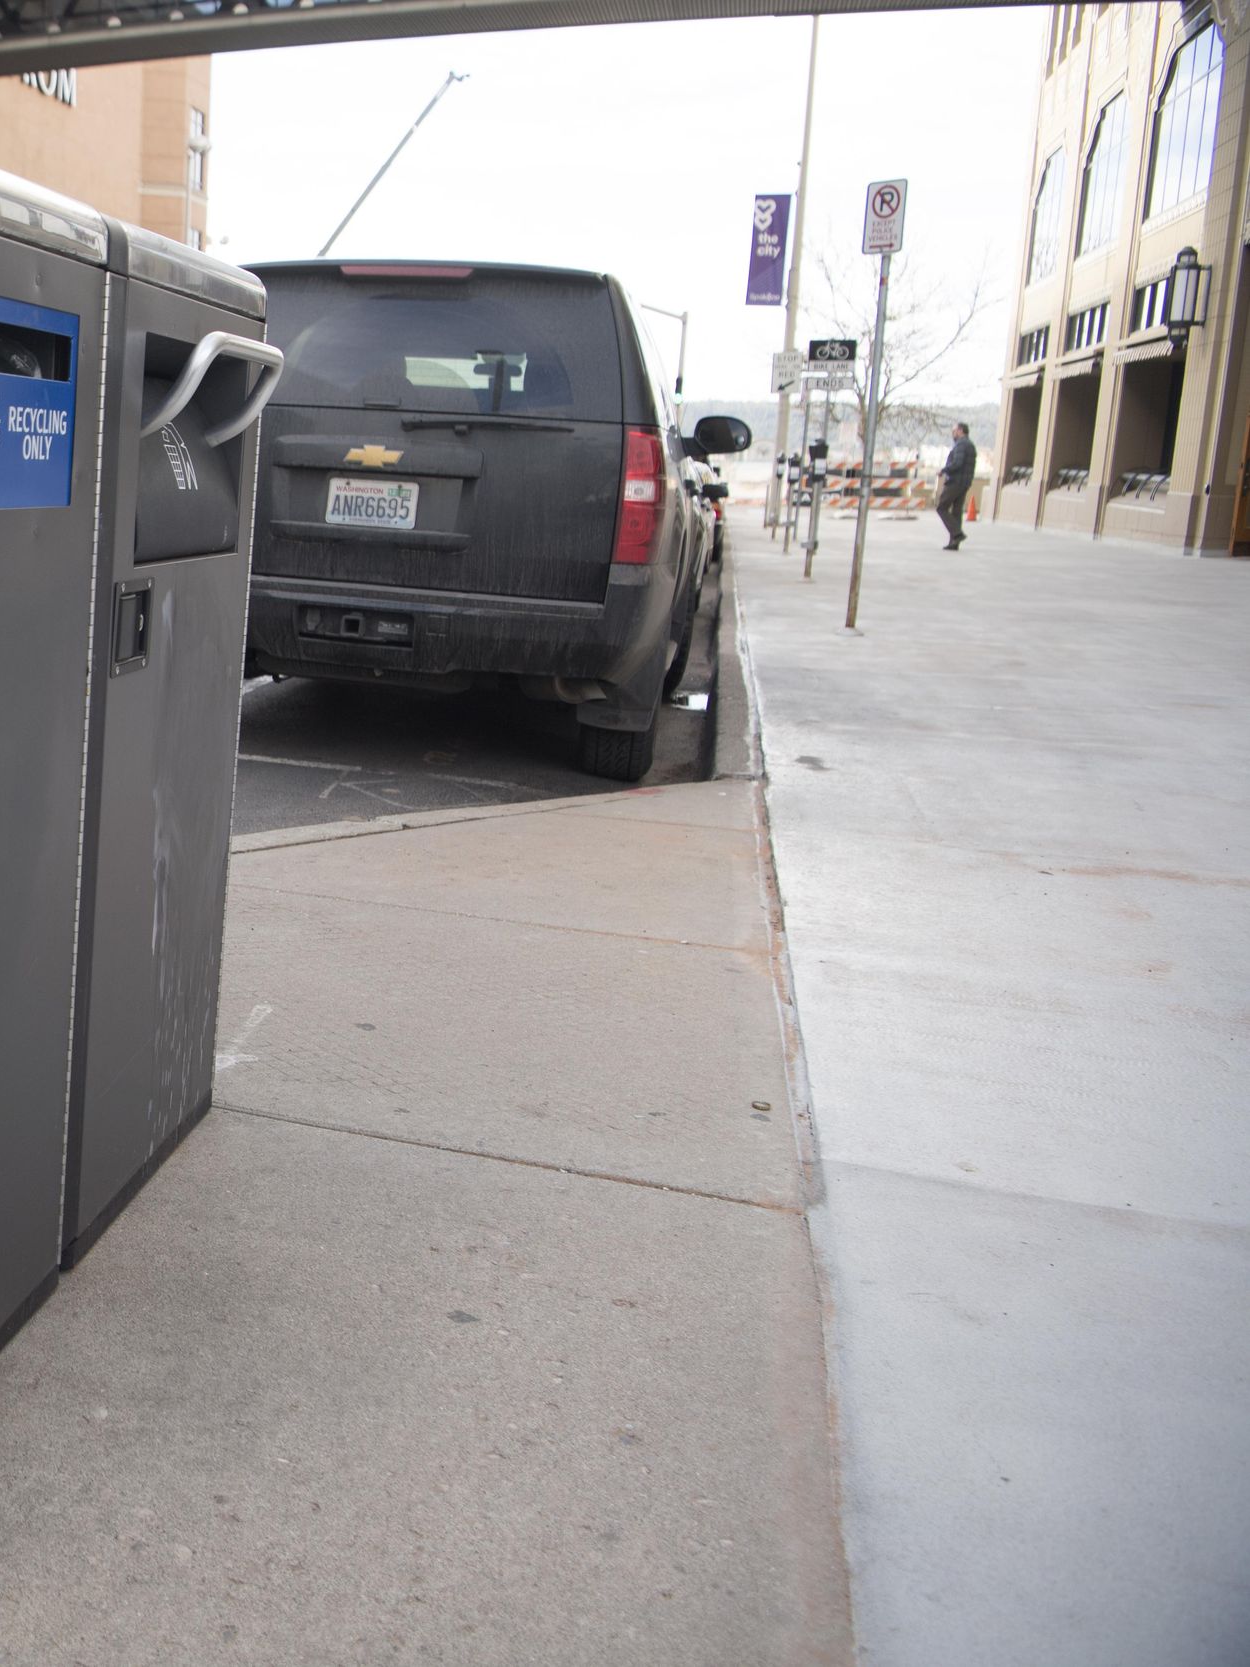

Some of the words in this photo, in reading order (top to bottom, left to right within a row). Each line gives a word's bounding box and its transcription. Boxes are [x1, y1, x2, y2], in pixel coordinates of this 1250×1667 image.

[758, 232, 779, 245] the
[756, 244, 781, 259] city
[816, 379, 844, 387] ENDS
[8, 406, 68, 435] RECYCLING
[22, 434, 53, 460] ONLY
[336, 485, 384, 495] WASHINGTON
[331, 494, 411, 520] ANR6695
